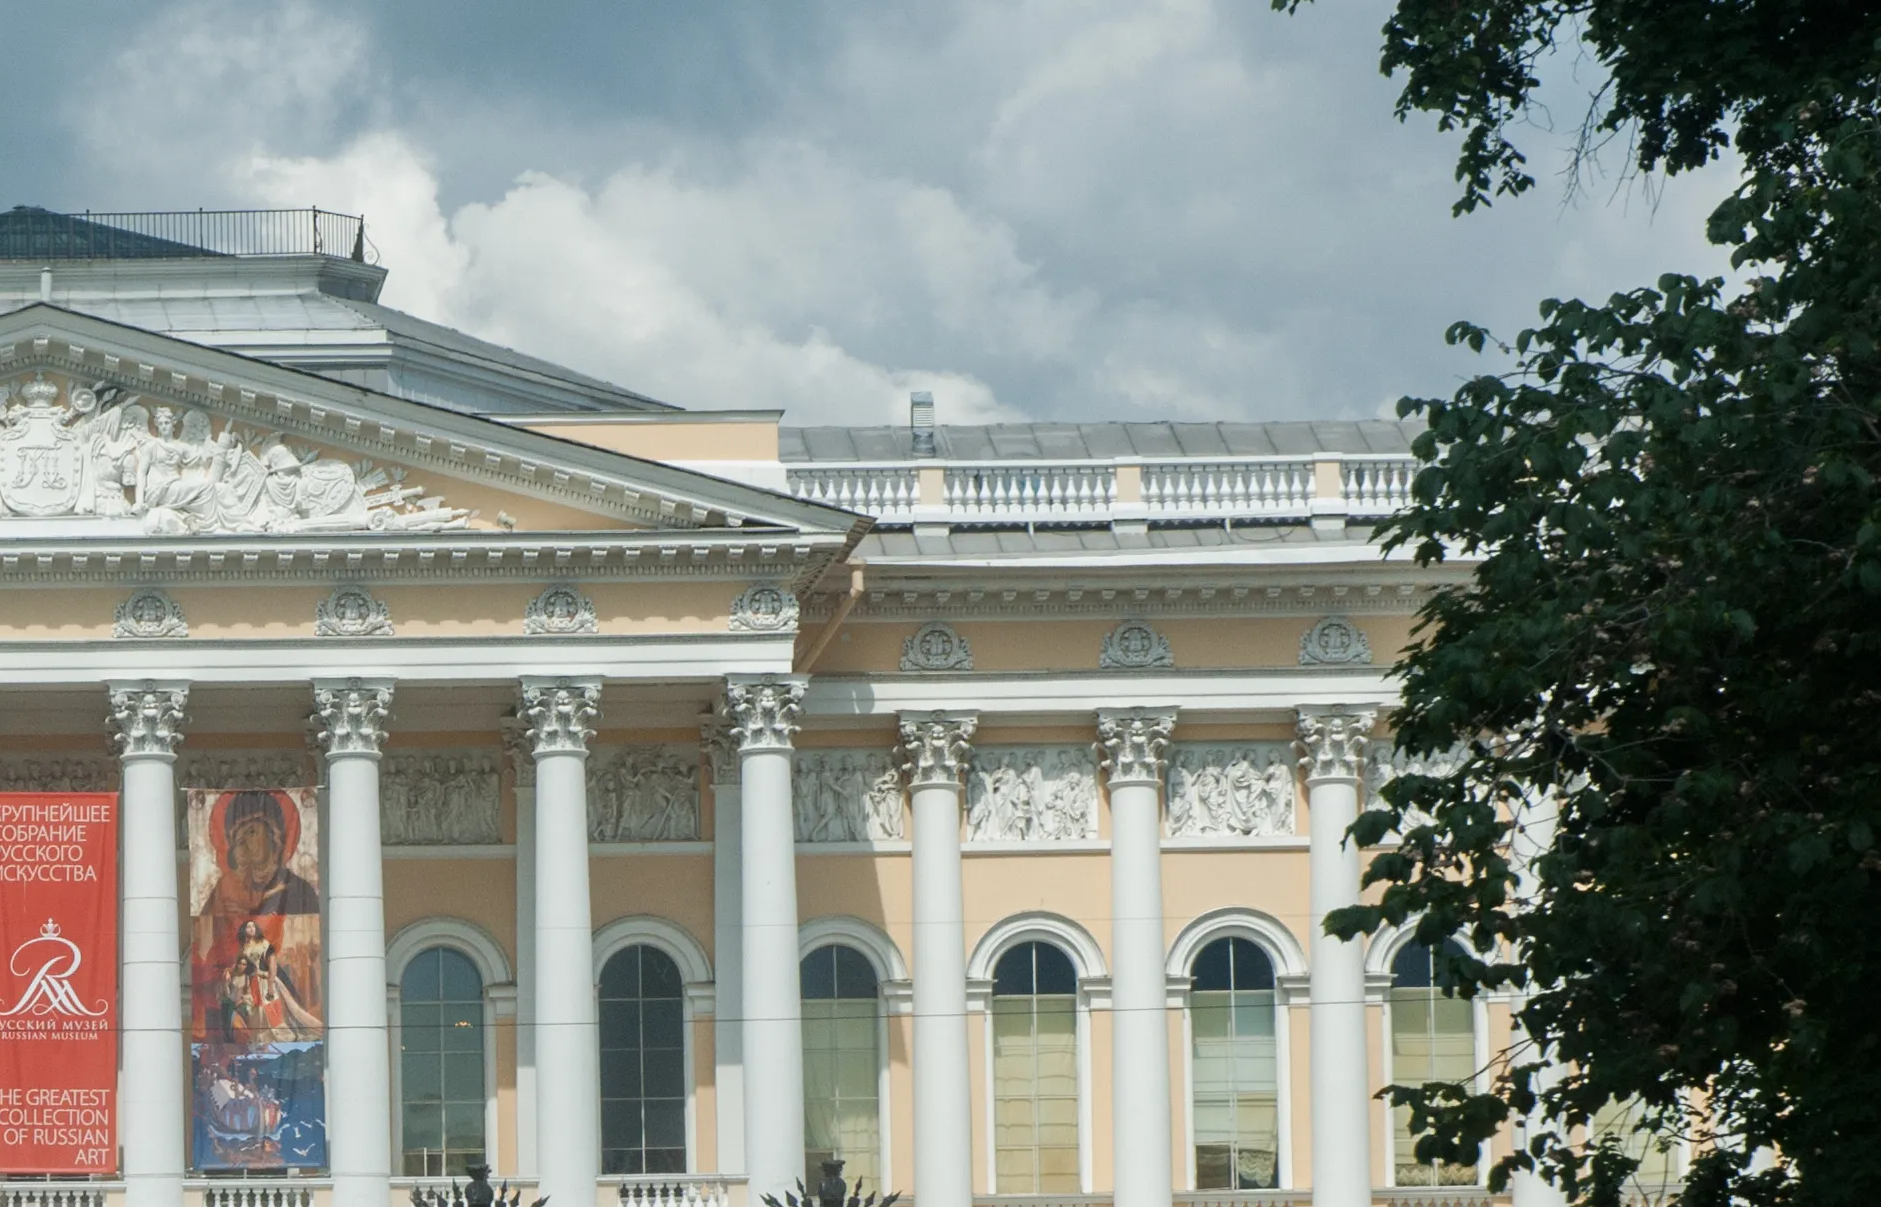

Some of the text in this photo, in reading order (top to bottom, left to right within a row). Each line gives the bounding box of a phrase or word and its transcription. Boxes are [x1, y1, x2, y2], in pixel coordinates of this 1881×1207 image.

[62, 1019, 109, 1031] МУЗЕЙ
[1, 1031, 98, 1040] RUSSIAN MUSEUM
[26, 1088, 110, 1106] GREATEST
[3, 1128, 109, 1145] OF RUSSIAN
[74, 1148, 110, 1165] ART
